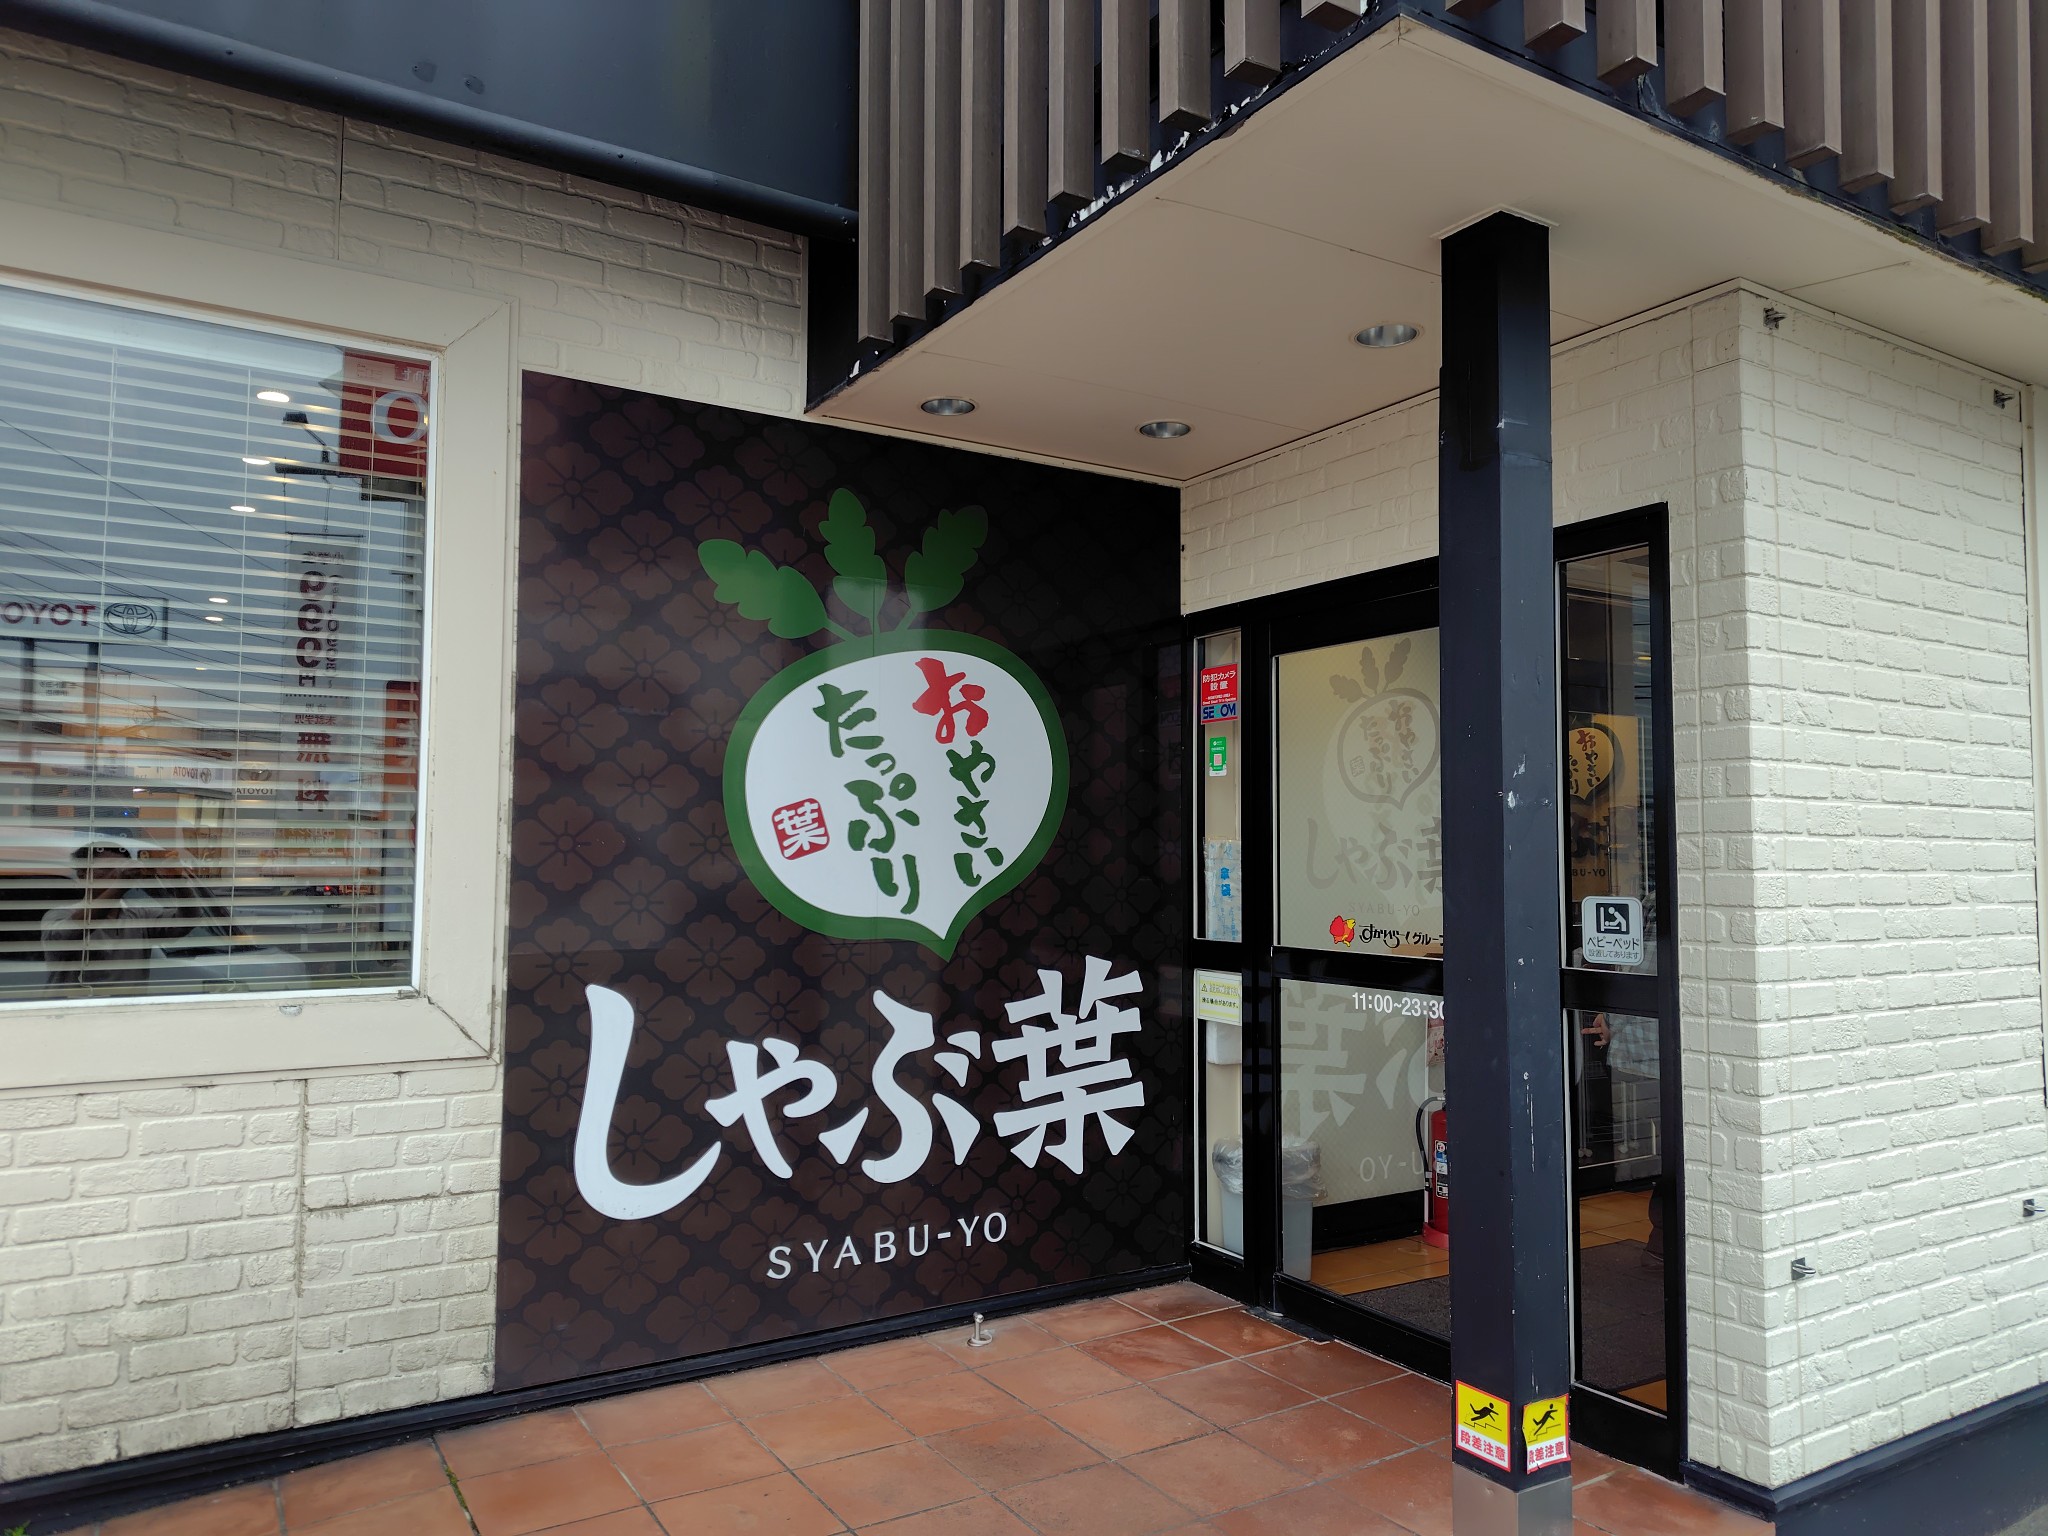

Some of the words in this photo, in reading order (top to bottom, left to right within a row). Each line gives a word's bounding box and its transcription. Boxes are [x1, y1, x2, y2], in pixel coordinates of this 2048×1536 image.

[1202, 670, 1237, 683] 防犯カメラ
[1209, 680, 1229, 696] 設置
[1202, 703, 1237, 719] SECOM
[912, 657, 1004, 887] おやさい
[812, 683, 920, 915] たっぷり
[773, 800, 829, 858] 葉
[1350, 902, 1421, 916] SYABU-YO
[1588, 949, 1640, 960] 設置してあります
[573, 955, 1145, 1220] しゃぶ葉
[766, 1212, 1008, 1281] SYABU-YO
[1460, 1430, 1506, 1462] 段差注意
